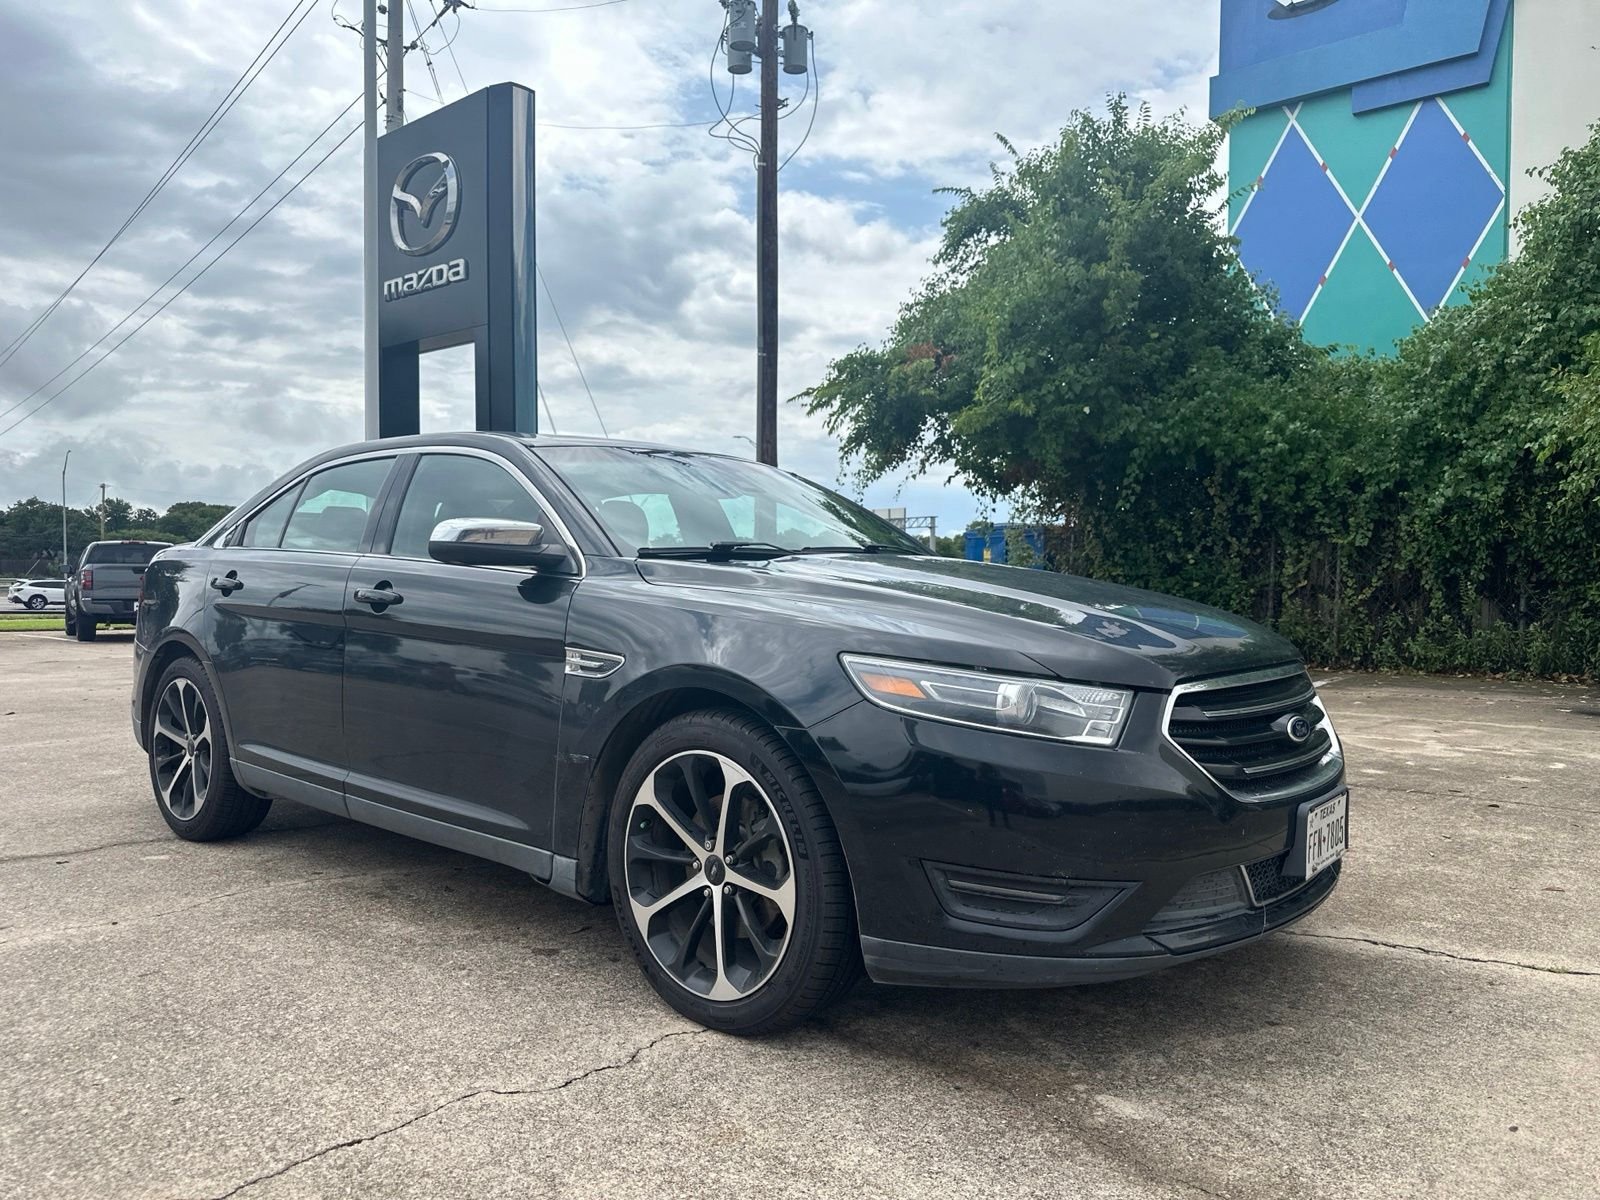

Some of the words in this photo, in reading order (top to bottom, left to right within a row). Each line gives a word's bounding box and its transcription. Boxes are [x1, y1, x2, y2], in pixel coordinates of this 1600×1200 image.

[383, 258, 468, 300] mazda
[762, 769, 807, 857] MICHELIN
[1319, 802, 1336, 821] TEXAS
